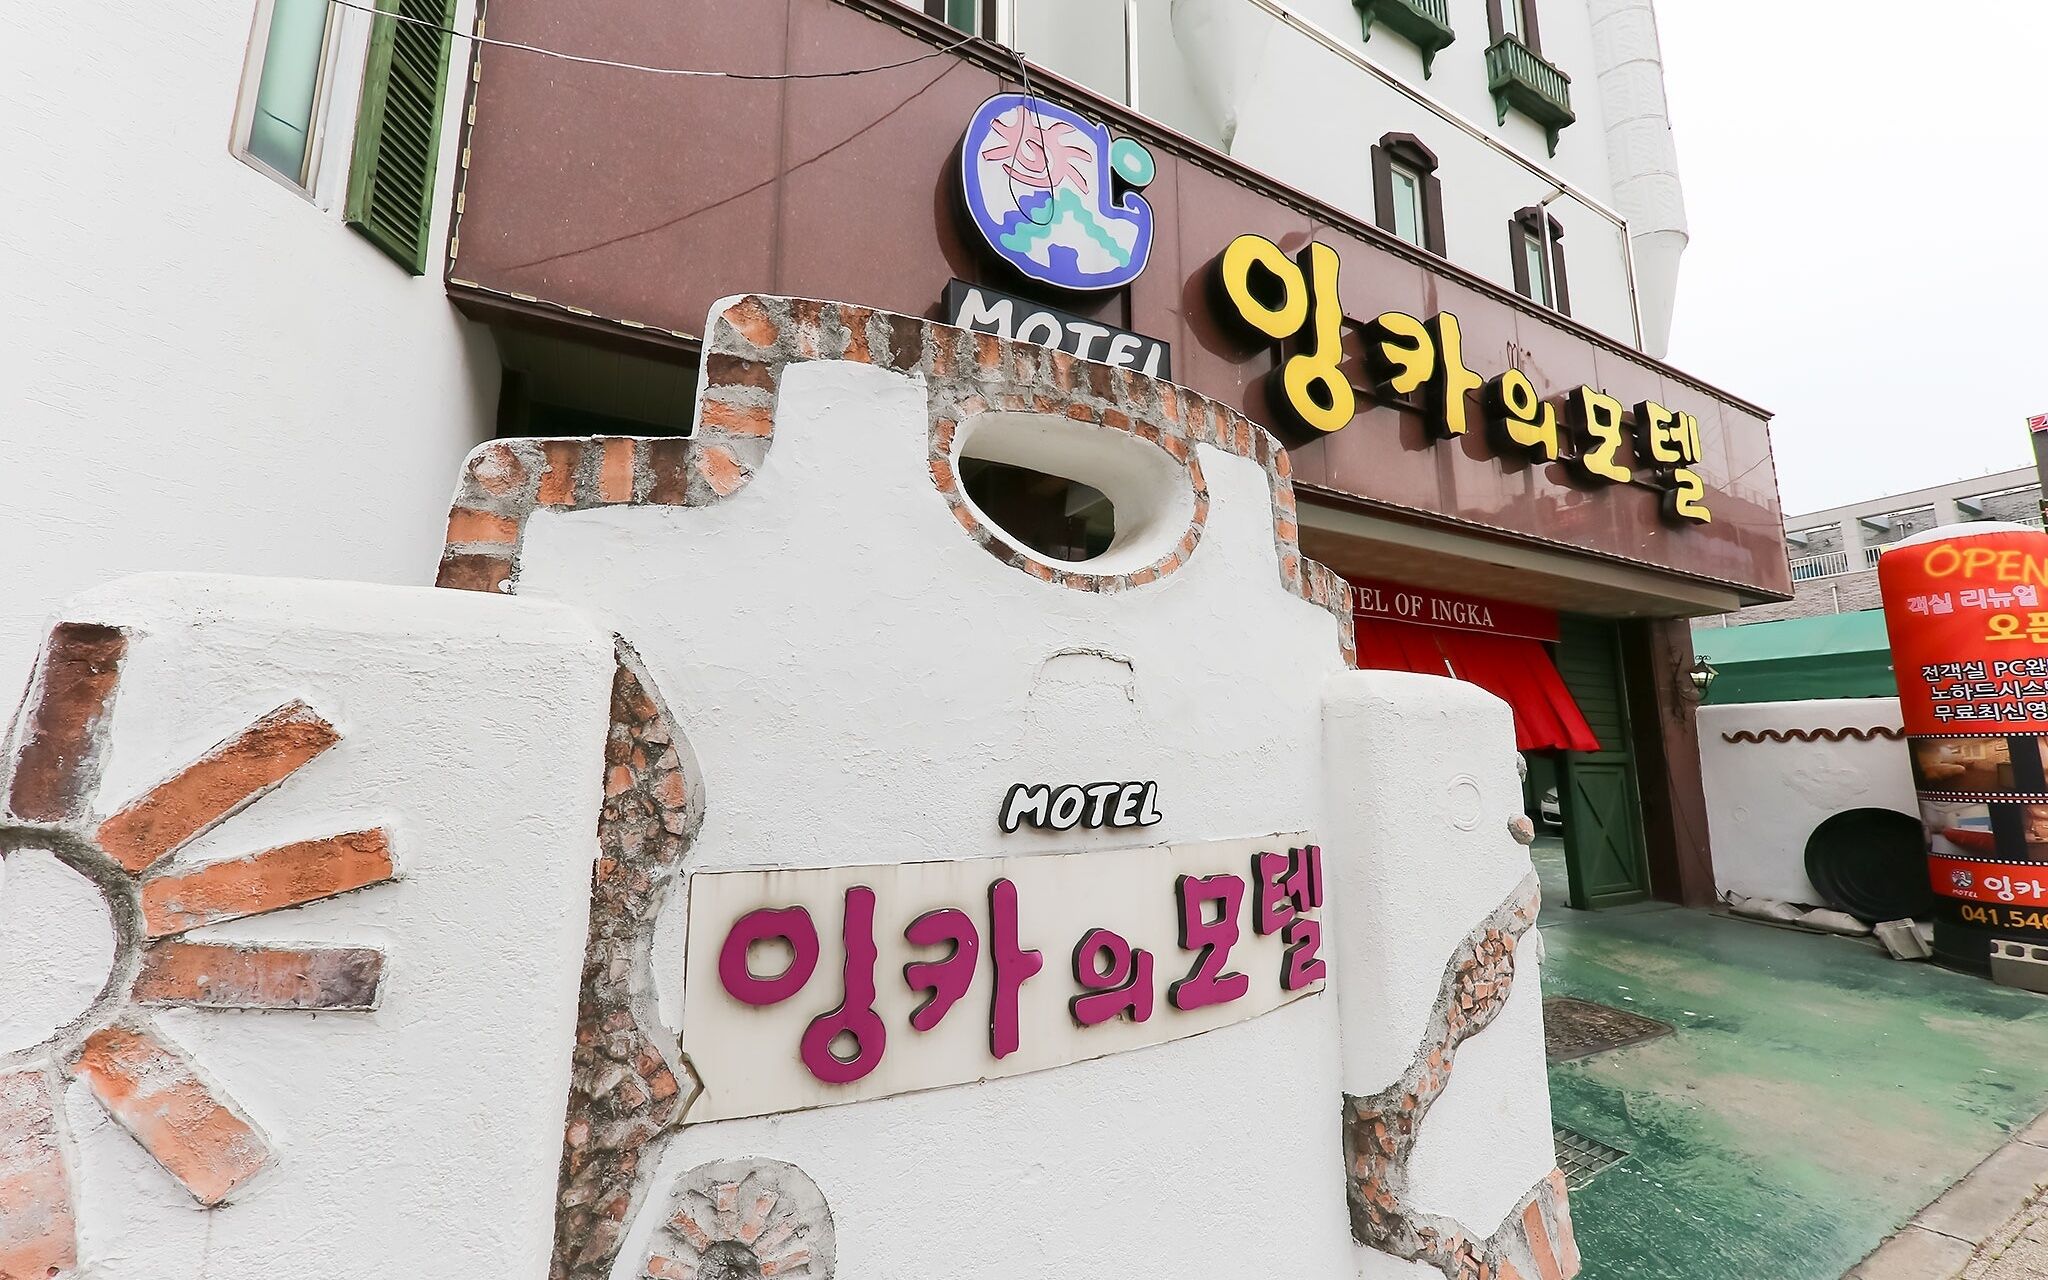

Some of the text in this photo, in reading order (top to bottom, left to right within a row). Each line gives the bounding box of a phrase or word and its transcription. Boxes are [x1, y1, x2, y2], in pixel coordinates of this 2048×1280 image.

[1924, 543, 2048, 588] OPEN
[1394, 592, 1424, 617] OF
[1430, 598, 1495, 628] INGKA
[1907, 584, 2039, 615] 객실 리뉴얼
[1922, 657, 2048, 682] 전객실 PC완
[1000, 781, 1163, 834] MOTEL
[1952, 888, 1979, 898] MOTEL
